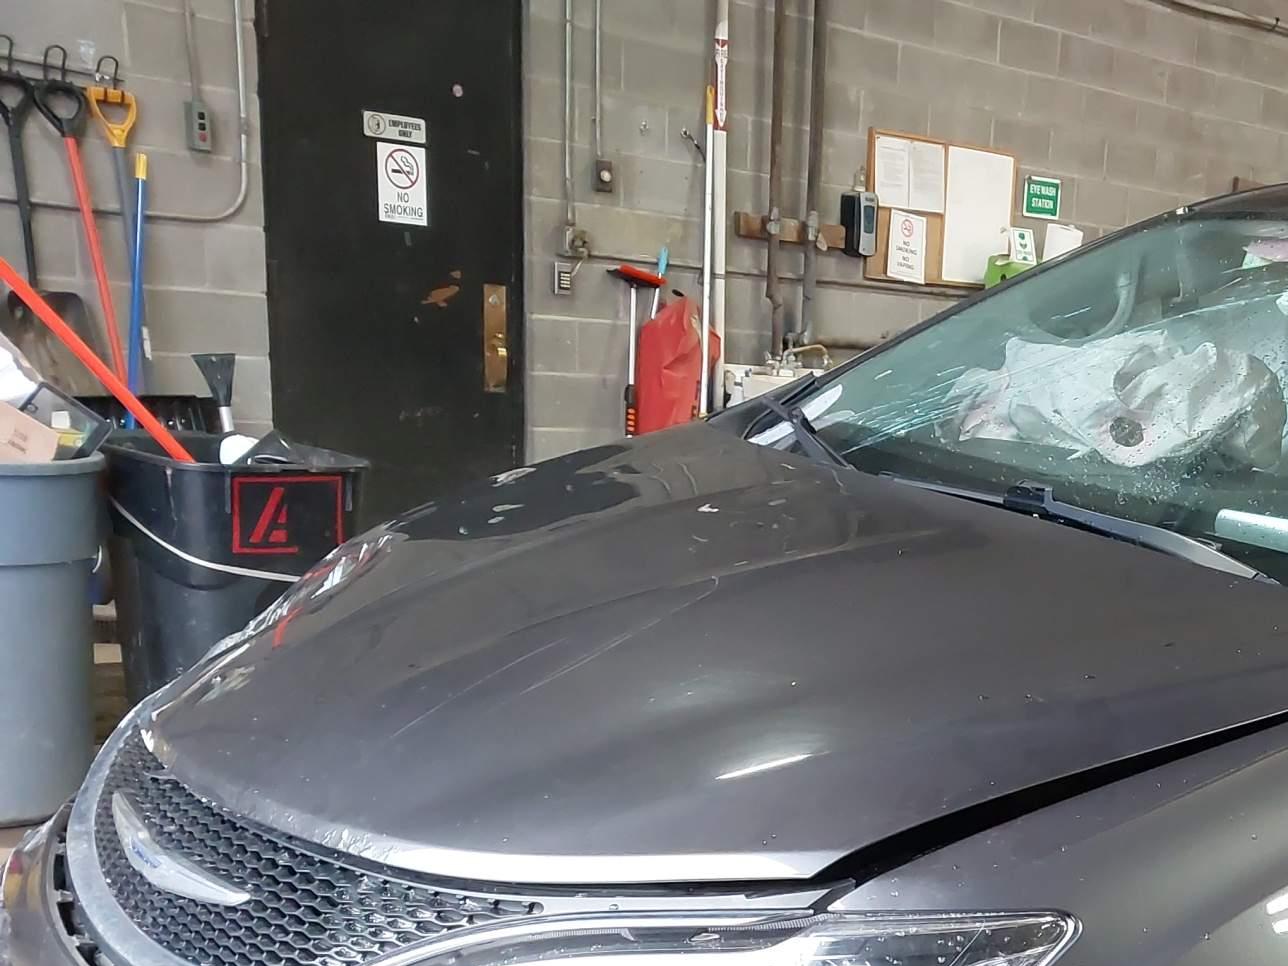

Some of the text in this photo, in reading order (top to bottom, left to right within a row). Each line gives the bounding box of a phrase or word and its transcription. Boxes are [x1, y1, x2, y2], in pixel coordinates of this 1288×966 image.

[388, 119, 421, 131] EMPLOYEES
[398, 129, 412, 138] ONLY
[397, 192, 409, 203] NO
[1031, 197, 1054, 209] STATION
[383, 203, 424, 218] SMOKING
[896, 245, 918, 256] SMOKING
